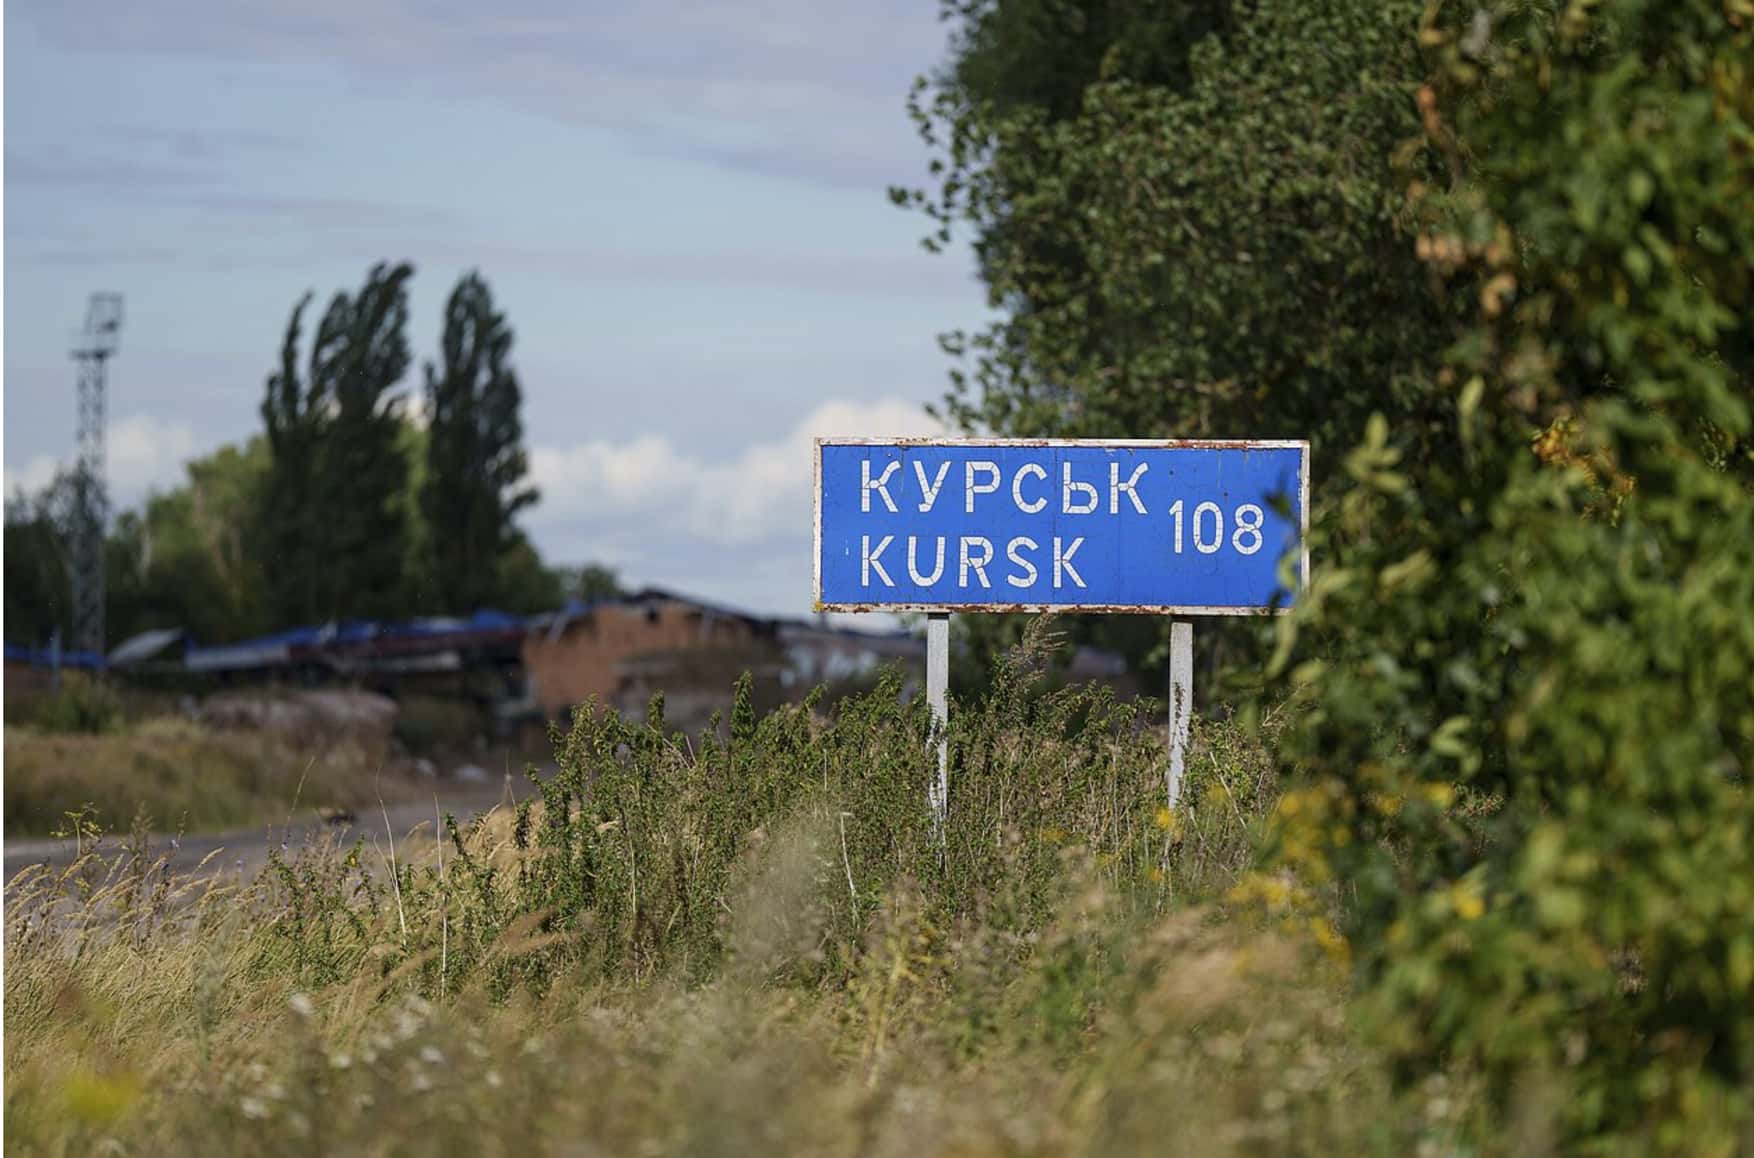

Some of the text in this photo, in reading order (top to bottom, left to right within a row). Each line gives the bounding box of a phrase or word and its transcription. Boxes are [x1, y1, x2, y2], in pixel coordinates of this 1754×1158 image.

[860, 459, 1150, 515] КУРСЬК
[1168, 499, 1265, 556] 108
[860, 534, 1088, 589] KURSK
